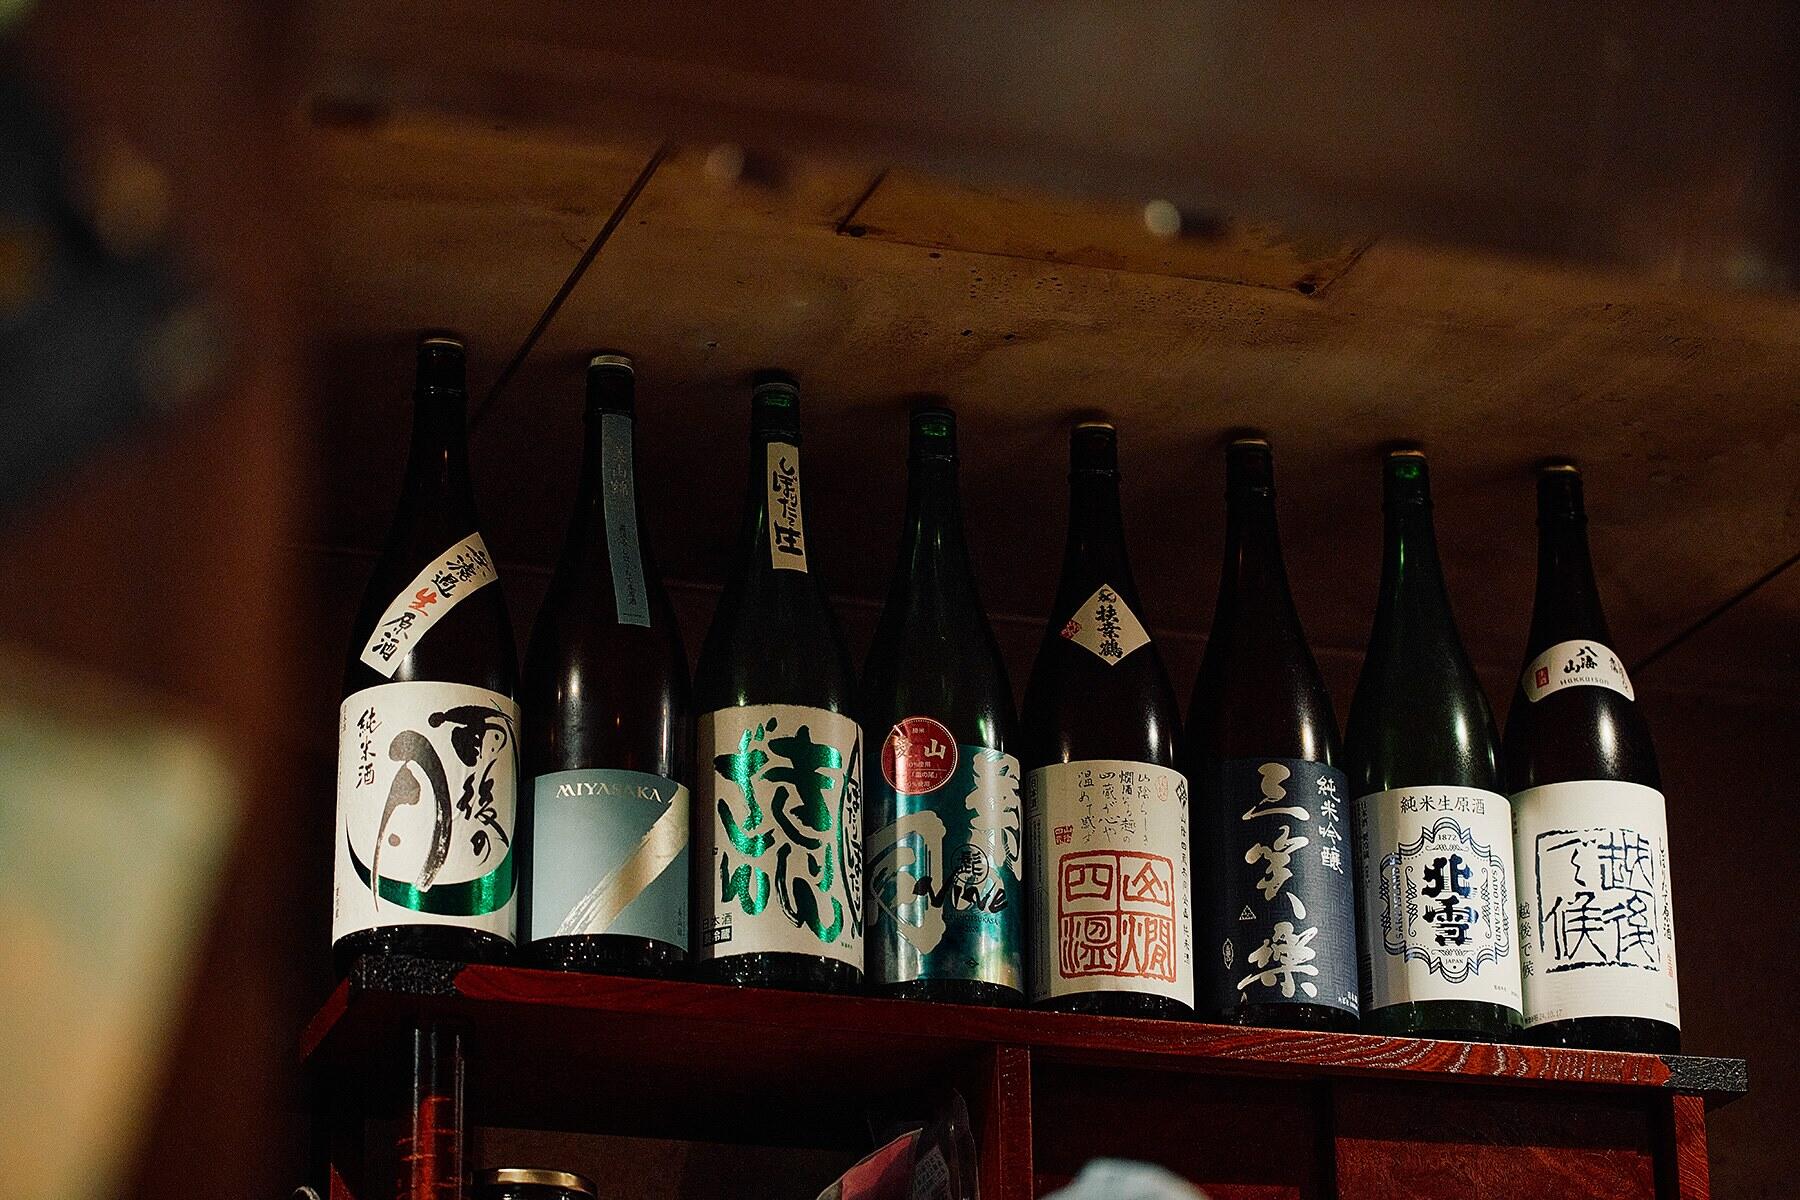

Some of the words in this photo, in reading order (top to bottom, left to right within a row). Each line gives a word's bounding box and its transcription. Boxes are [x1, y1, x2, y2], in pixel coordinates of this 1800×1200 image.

[1563, 645, 1598, 674] 八海山
[355, 706, 383, 790] 純米酒
[556, 782, 663, 803] MIYASAKA
[1400, 795, 1486, 815] 純米生原酒
[1316, 775, 1345, 875] 純米吟醸
[1437, 833, 1458, 842] 1872
[1491, 869, 1499, 898] SADO
[1421, 853, 1479, 947] 北雪
[1493, 901, 1502, 942] ISLAND
[1518, 904, 1534, 978] 越後で候
[1445, 957, 1464, 965] JAPAN
